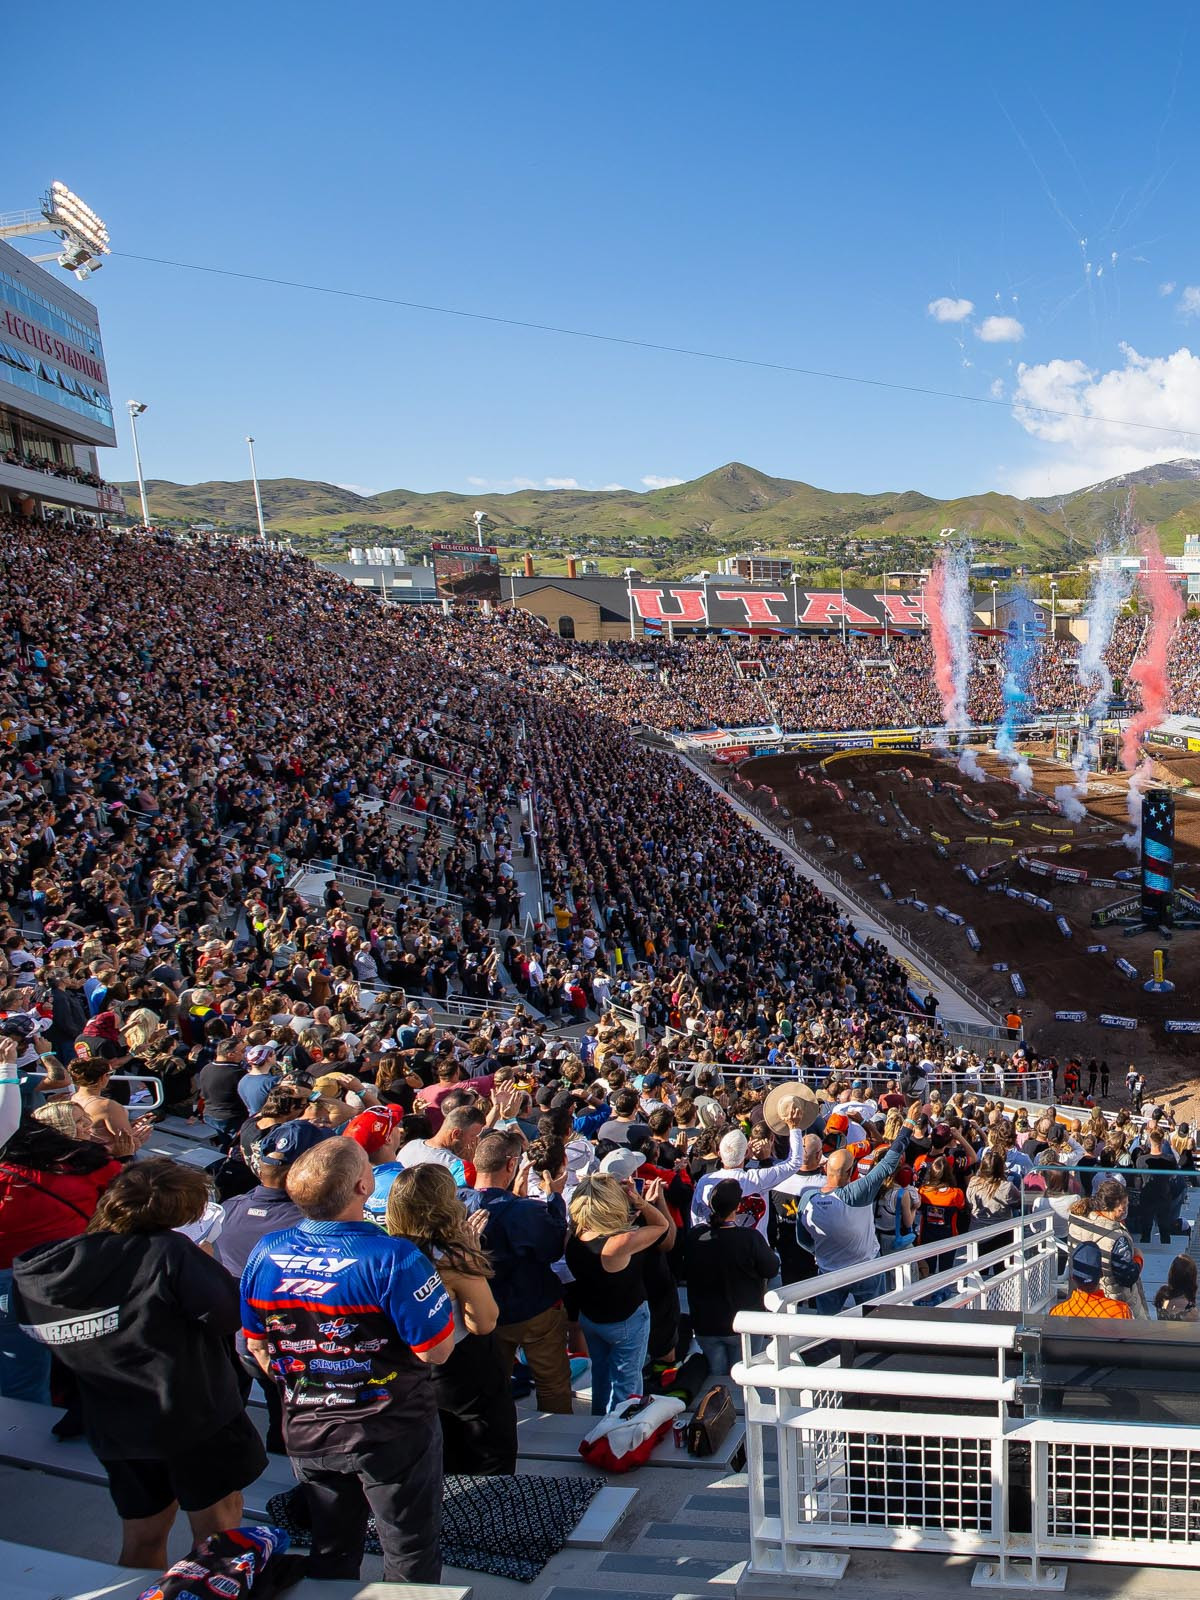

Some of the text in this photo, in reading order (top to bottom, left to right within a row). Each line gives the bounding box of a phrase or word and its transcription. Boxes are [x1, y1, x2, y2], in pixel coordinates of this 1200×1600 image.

[54, 339, 103, 384] STADIUM
[627, 588, 931, 624] UTAH
[1105, 709, 1135, 719] FINISH
[835, 739, 873, 748] FALKEN
[1107, 900, 1141, 919] MONSTER
[1101, 1017, 1137, 1028] FALKEN
[291, 1244, 341, 1254] TEAM
[269, 1254, 359, 1273] FLY
[282, 1268, 333, 1278] RACING
[46, 1312, 119, 1342] RACING
[75, 1332, 96, 1342] RACE
[95, 1325, 120, 1337] SHOP
